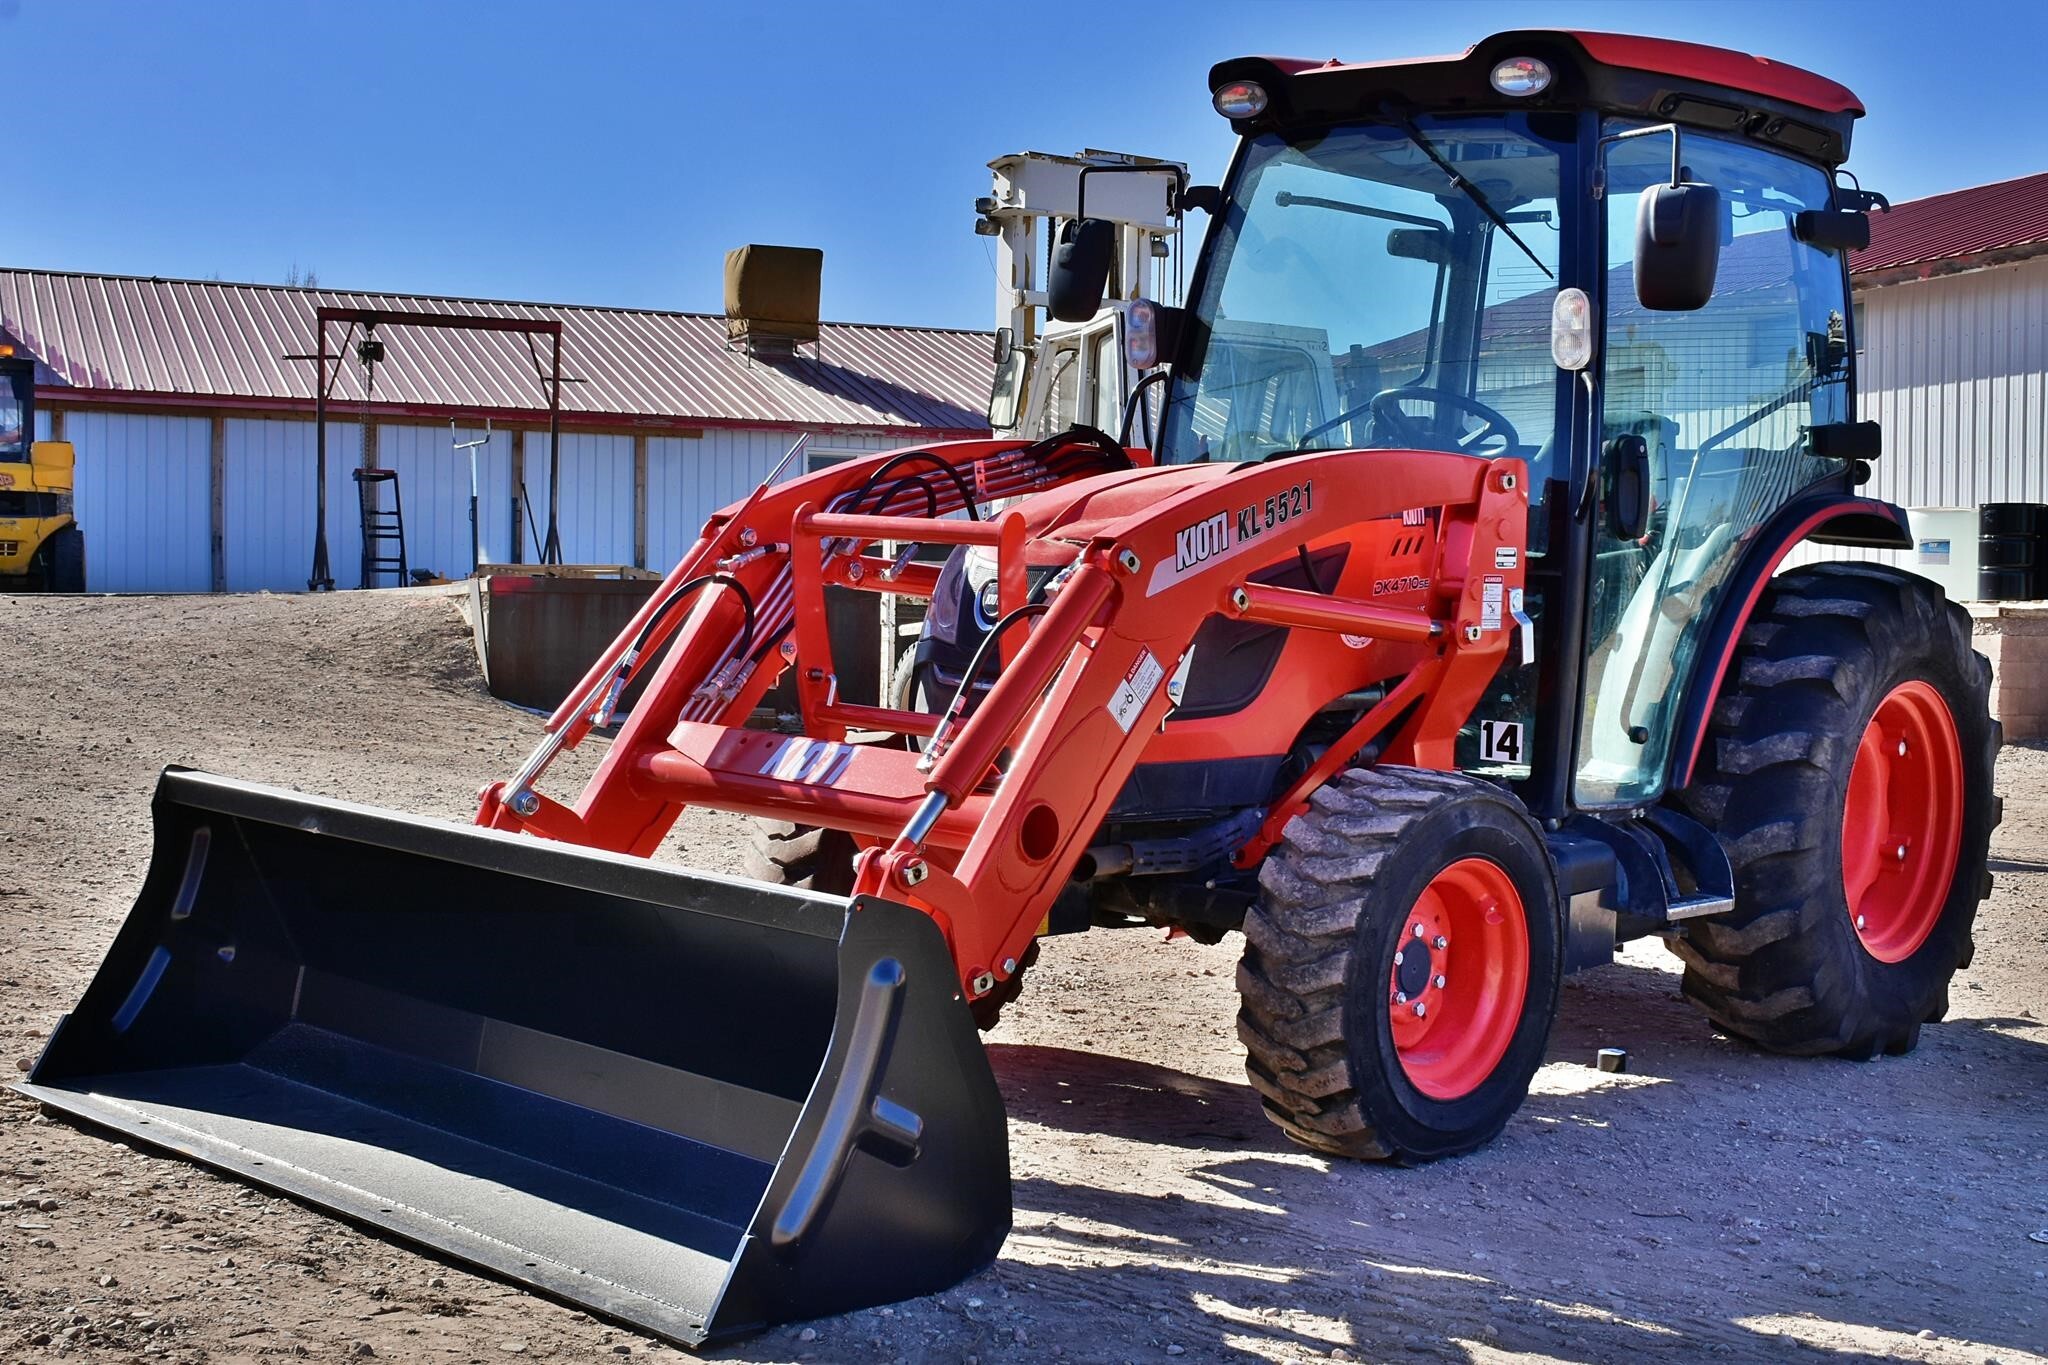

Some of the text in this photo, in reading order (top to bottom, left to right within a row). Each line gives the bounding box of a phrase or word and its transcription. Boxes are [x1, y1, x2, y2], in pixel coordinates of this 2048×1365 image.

[1402, 507, 1425, 527] KIOTI
[1176, 511, 1229, 573] KIOTI
[1130, 648, 1147, 675] DANGER
[758, 736, 861, 785] KIOTI
[1482, 721, 1520, 761] 14
